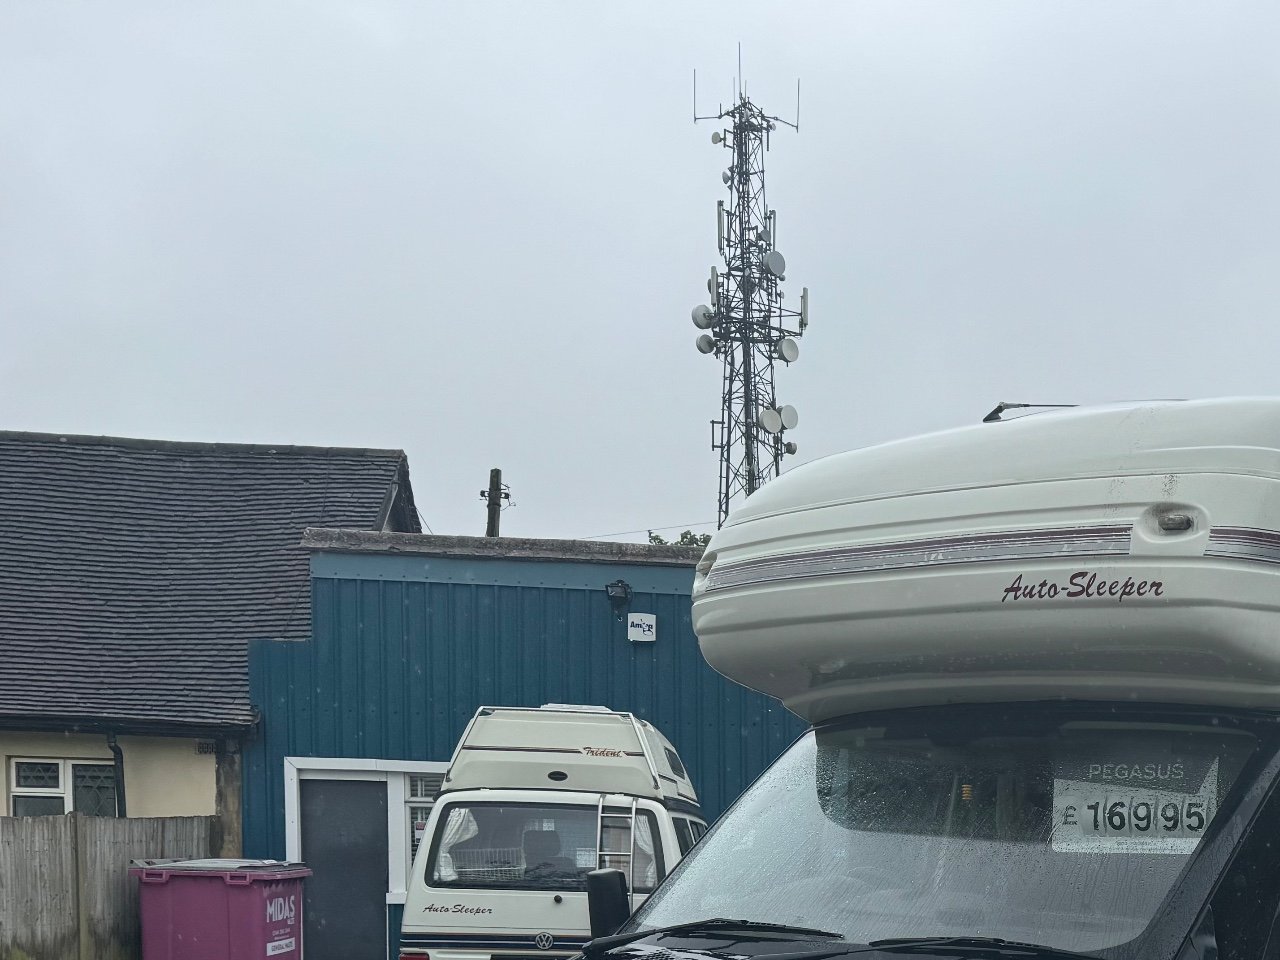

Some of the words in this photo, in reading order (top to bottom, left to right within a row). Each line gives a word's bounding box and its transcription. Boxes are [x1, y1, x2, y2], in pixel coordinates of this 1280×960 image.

[1002, 571, 1164, 602] Auto-Sleeper
[1089, 763, 1184, 780] PEGASUS
[1063, 805, 1078, 826] £
[1087, 801, 1205, 832] 16995
[266, 895, 295, 924] MIDAS
[423, 903, 493, 916] Auto-Sleeper
